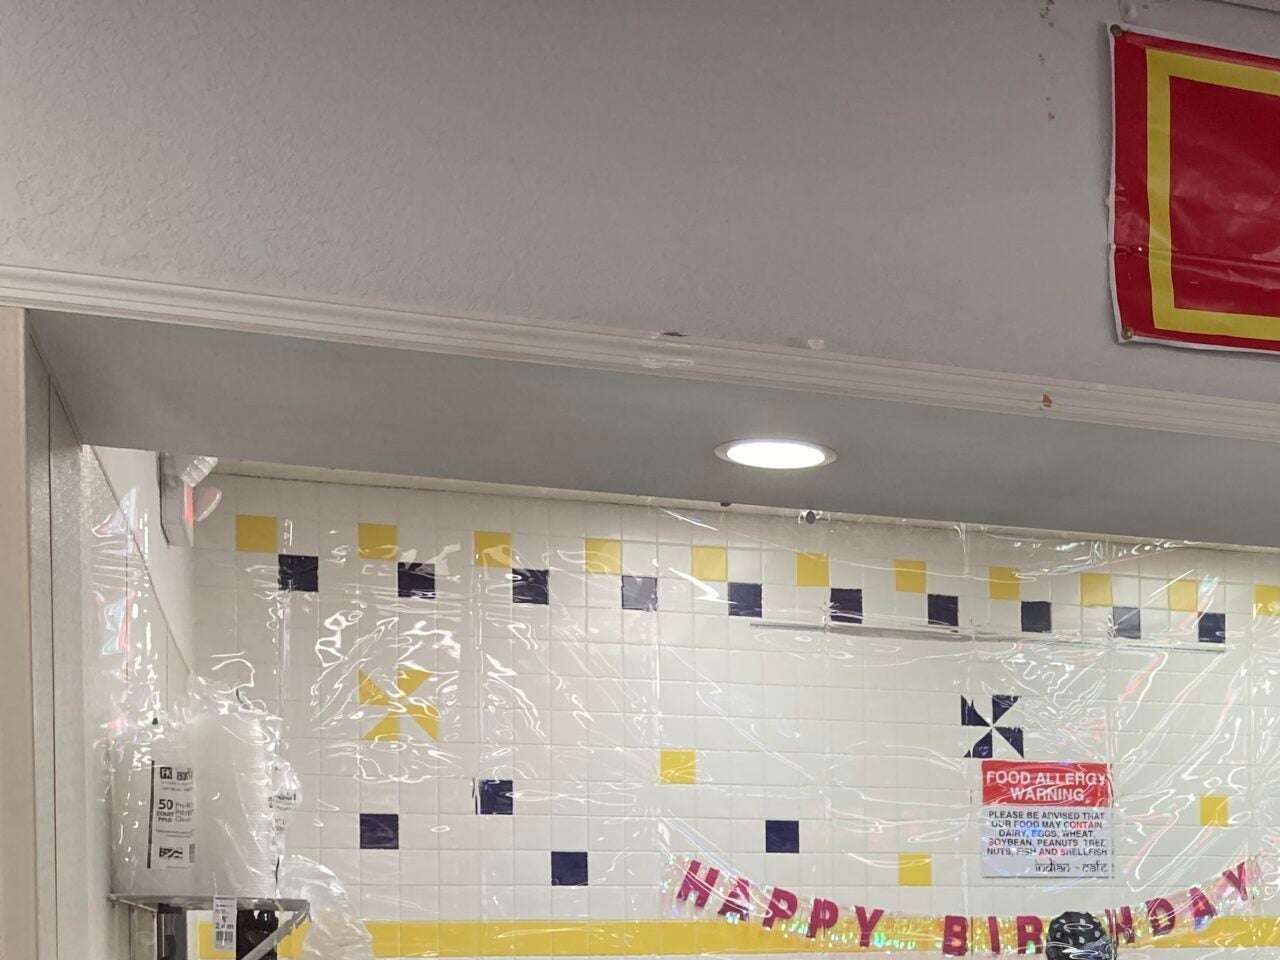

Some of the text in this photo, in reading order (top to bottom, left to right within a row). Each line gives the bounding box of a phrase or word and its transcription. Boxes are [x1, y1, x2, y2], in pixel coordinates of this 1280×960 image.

[987, 771, 1106, 786] FOOD ALLERGY
[1010, 788, 1084, 800] WARNING
[158, 799, 173, 810] 50
[989, 811, 1023, 819] PLEASE
[992, 820, 1011, 828] OUR
[999, 829, 1095, 838] DAIRY, EGGS, WHEAT,
[989, 838, 1034, 847] SOYBEAN,
[987, 848, 1013, 856] NUTS,
[677, 859, 1255, 957] HAPPY BIRHDAY
